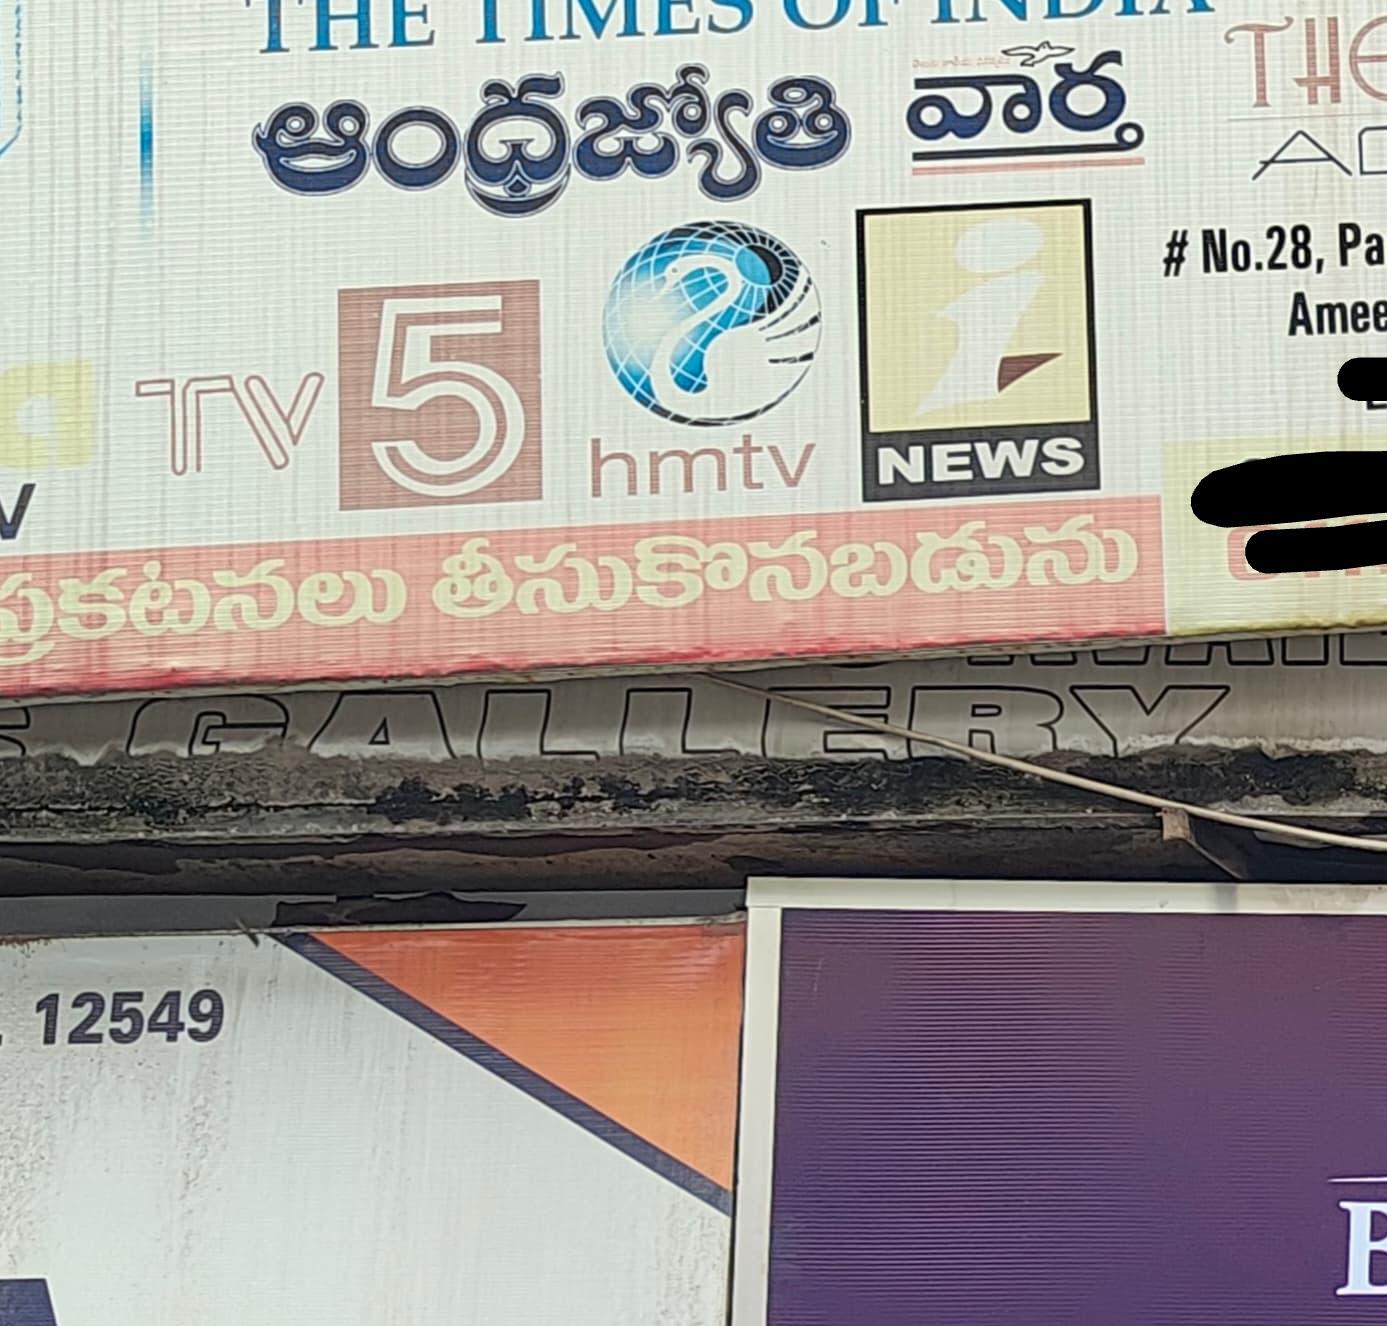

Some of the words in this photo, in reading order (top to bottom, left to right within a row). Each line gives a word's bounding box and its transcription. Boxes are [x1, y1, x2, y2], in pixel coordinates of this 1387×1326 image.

[252, 64, 852, 217] ఆంధ్రజ్యోతి
[1201, 224, 1326, 275] No.28,
[590, 434, 817, 499] hmtv
[877, 437, 1086, 485] NEWS
[35, 988, 225, 1045] 12549
